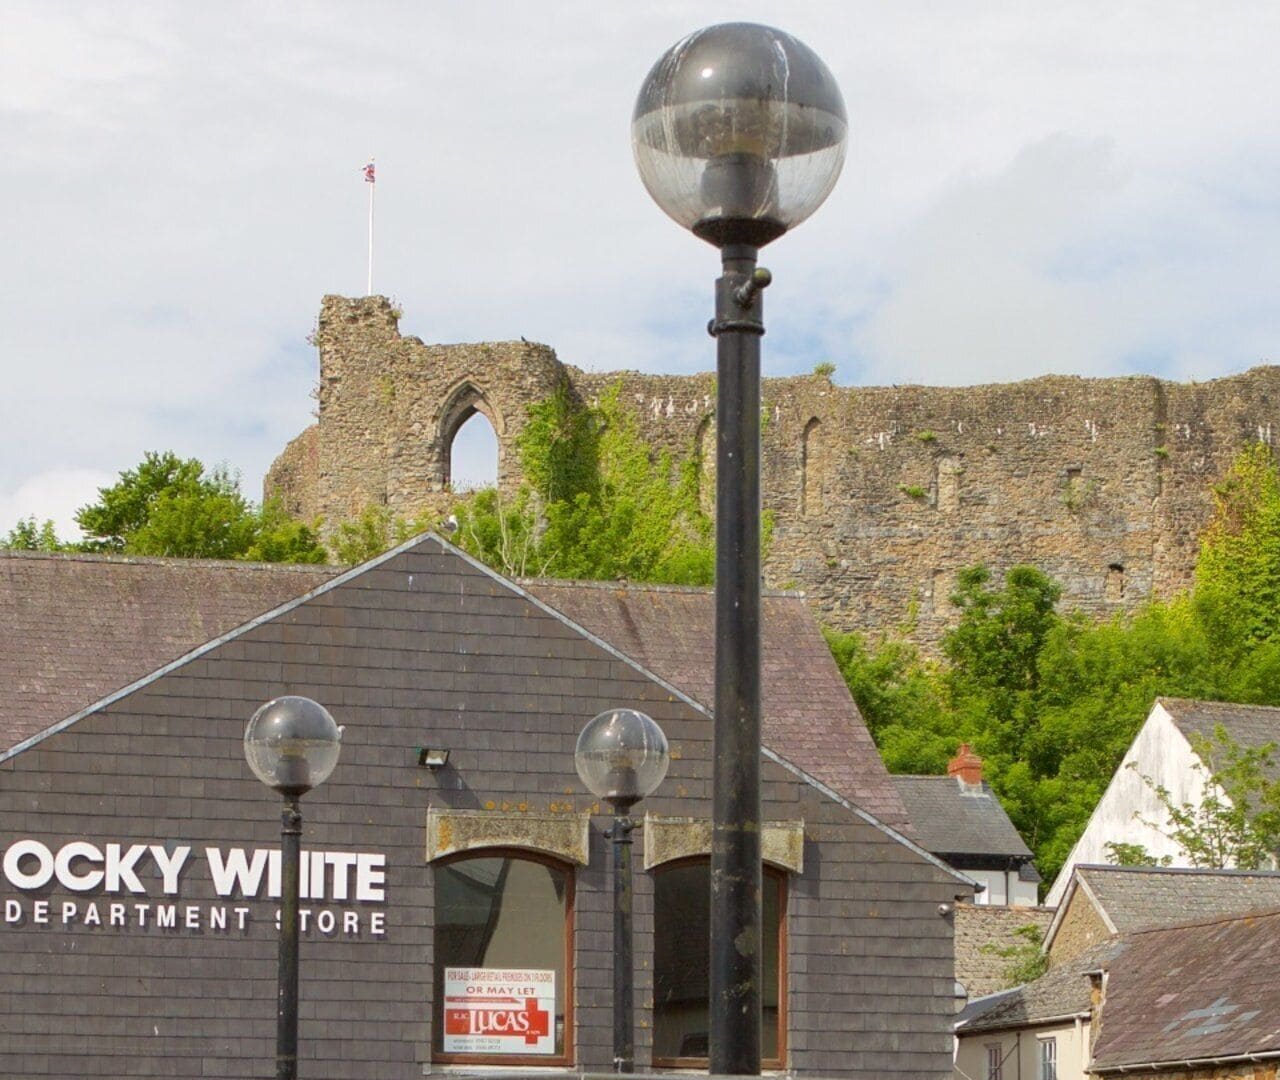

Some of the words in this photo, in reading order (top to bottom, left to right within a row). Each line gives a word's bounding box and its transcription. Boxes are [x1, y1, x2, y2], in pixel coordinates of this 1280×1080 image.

[3, 839, 191, 894] OCKY
[205, 847, 386, 902] WHITE
[5, 900, 249, 930] DEPARTMENT
[466, 986, 483, 994] OR
[487, 986, 514, 995] MAY
[517, 987, 536, 996] LET
[469, 1010, 529, 1034] LUCAS
